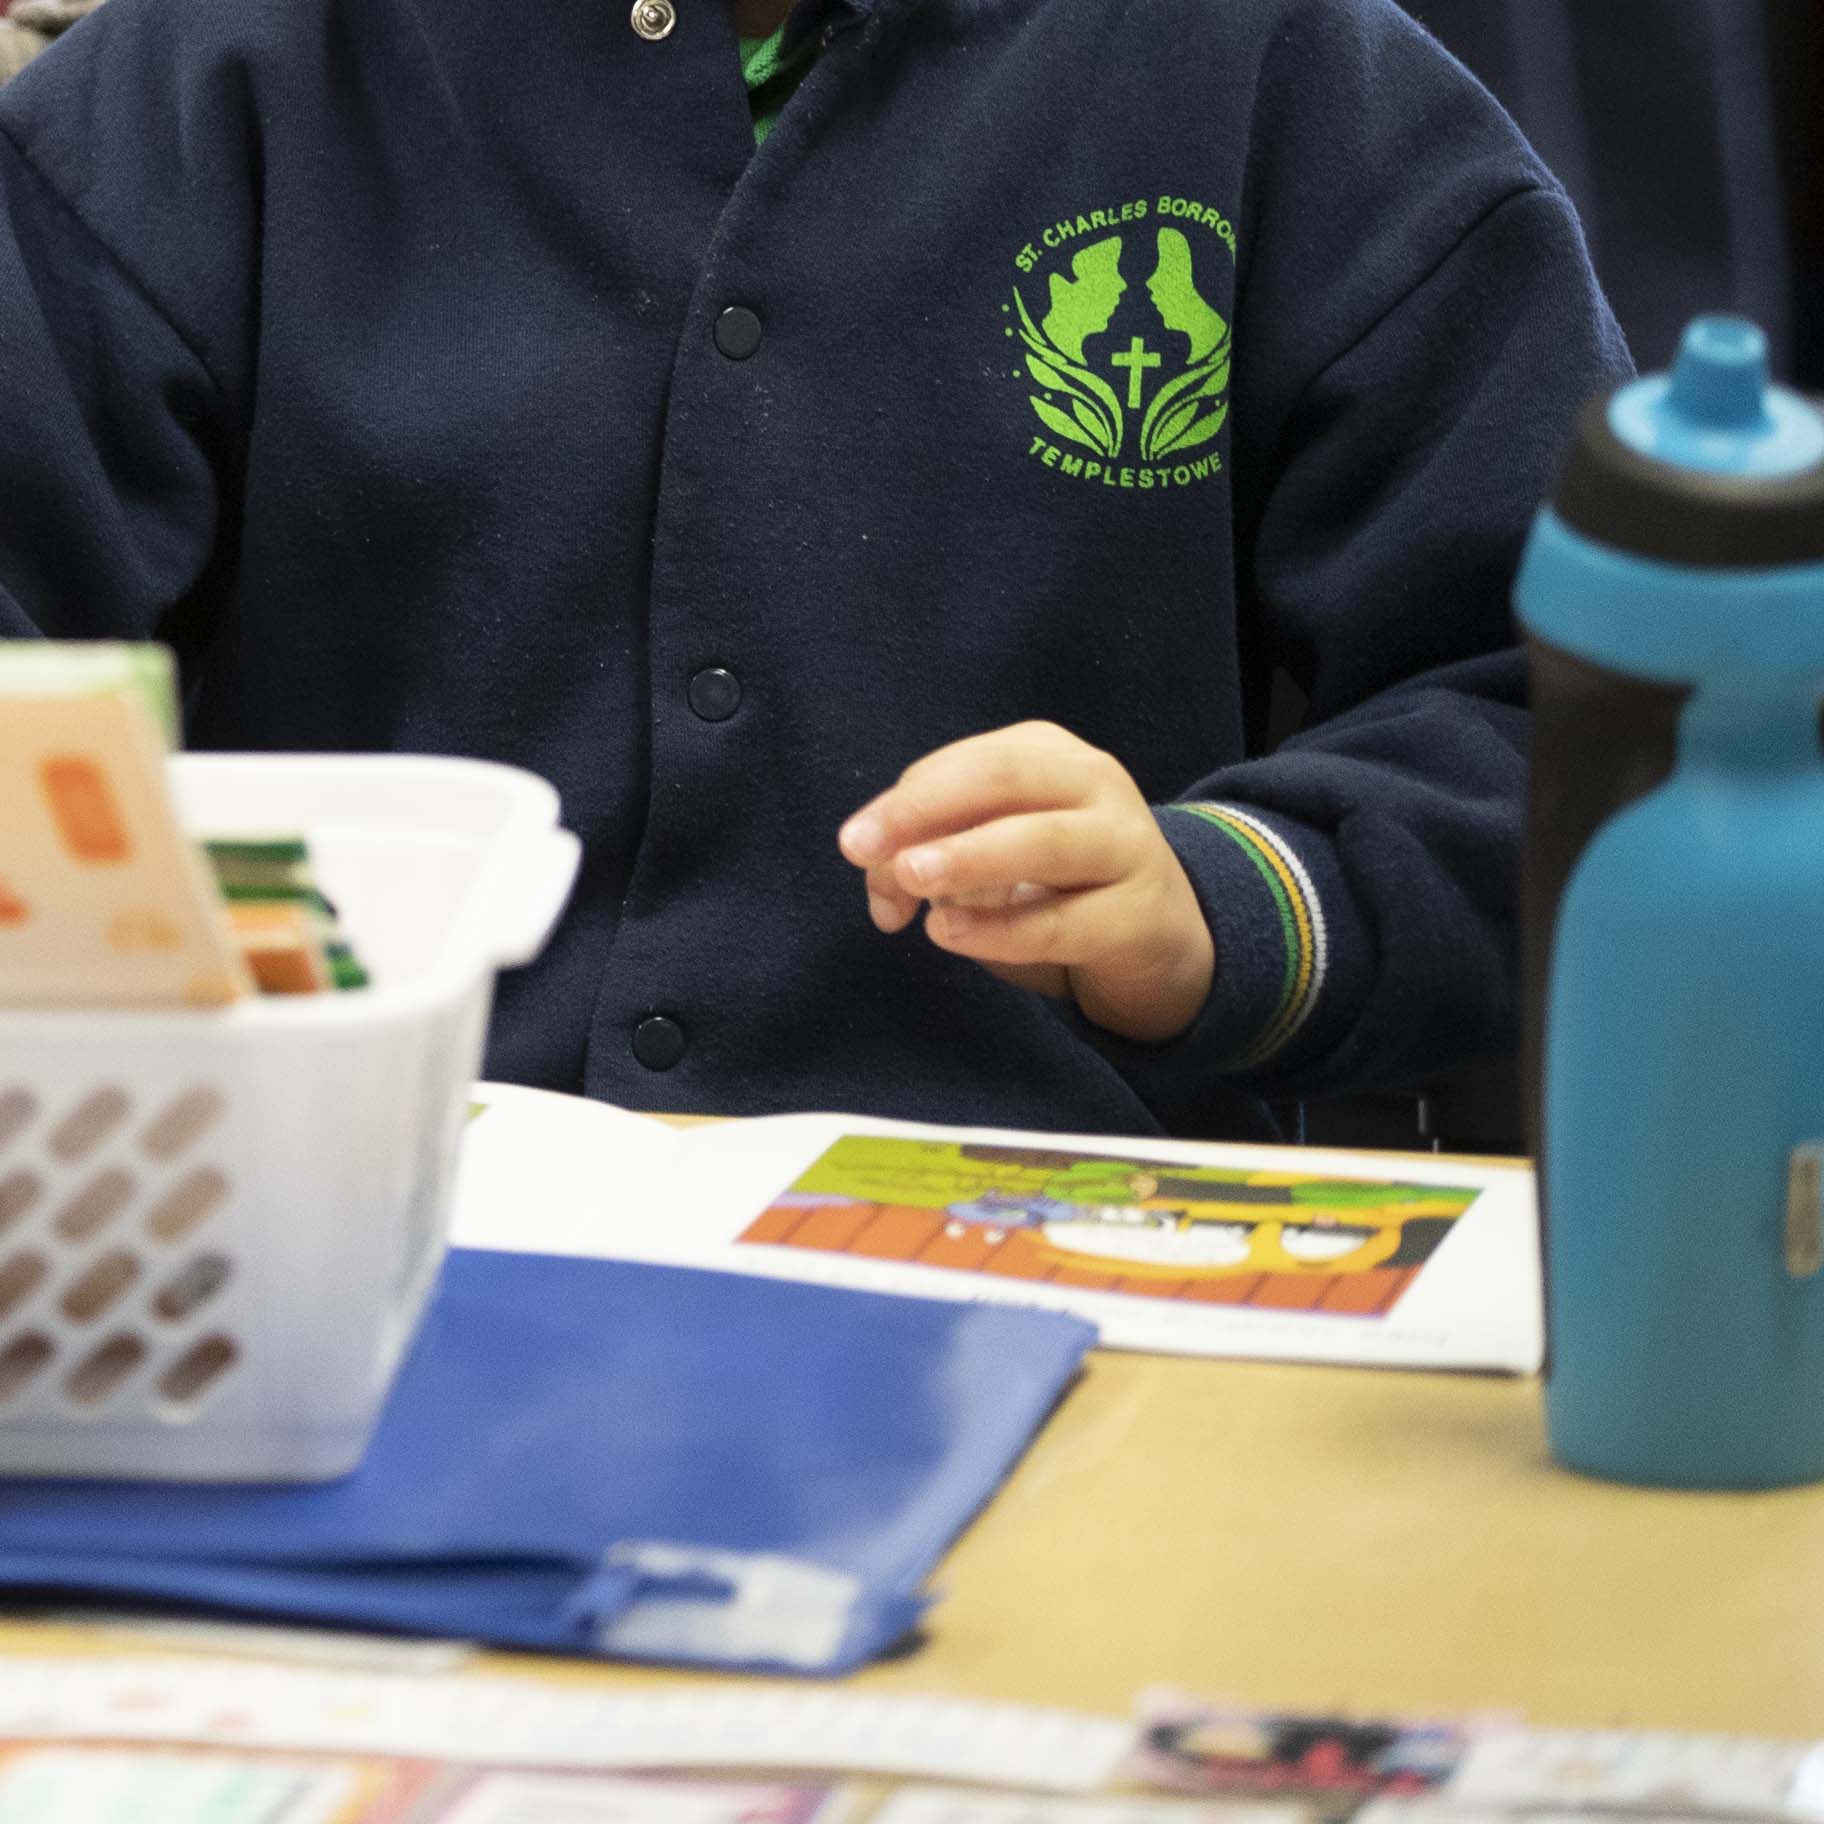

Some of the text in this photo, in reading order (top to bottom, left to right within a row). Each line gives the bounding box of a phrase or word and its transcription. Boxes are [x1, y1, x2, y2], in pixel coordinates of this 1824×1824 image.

[1015, 242, 1042, 273] ST.
[1042, 199, 1148, 248] CHARLES
[1028, 436, 1223, 489] TEMPLESTOWE
